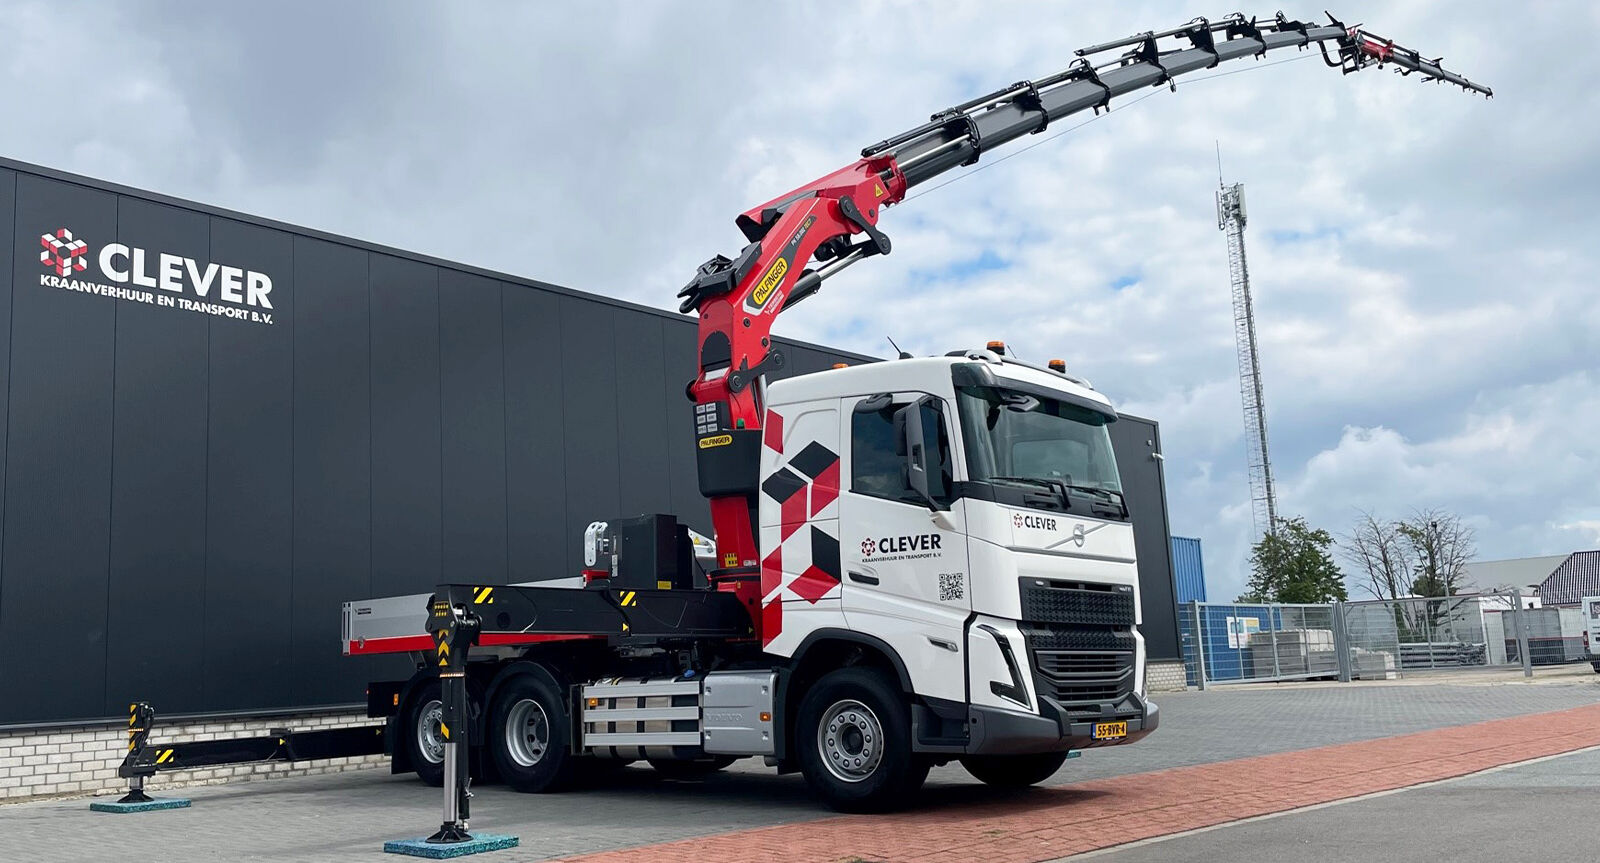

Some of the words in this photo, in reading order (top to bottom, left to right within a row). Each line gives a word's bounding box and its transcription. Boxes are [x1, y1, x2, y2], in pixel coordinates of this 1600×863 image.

[99, 243, 273, 309] CLEVER
[755, 261, 786, 301] PALFINGER
[40, 274, 154, 304] KRAANVERHUUR
[157, 295, 175, 308] EN
[178, 298, 249, 320] TRANSPORT
[251, 311, 273, 325] B.V.
[700, 436, 730, 447] PALFINGER
[1024, 515, 1057, 531] CLEVER
[879, 534, 941, 553] CLEVER
[1097, 722, 1126, 737] 55-BVR-4
